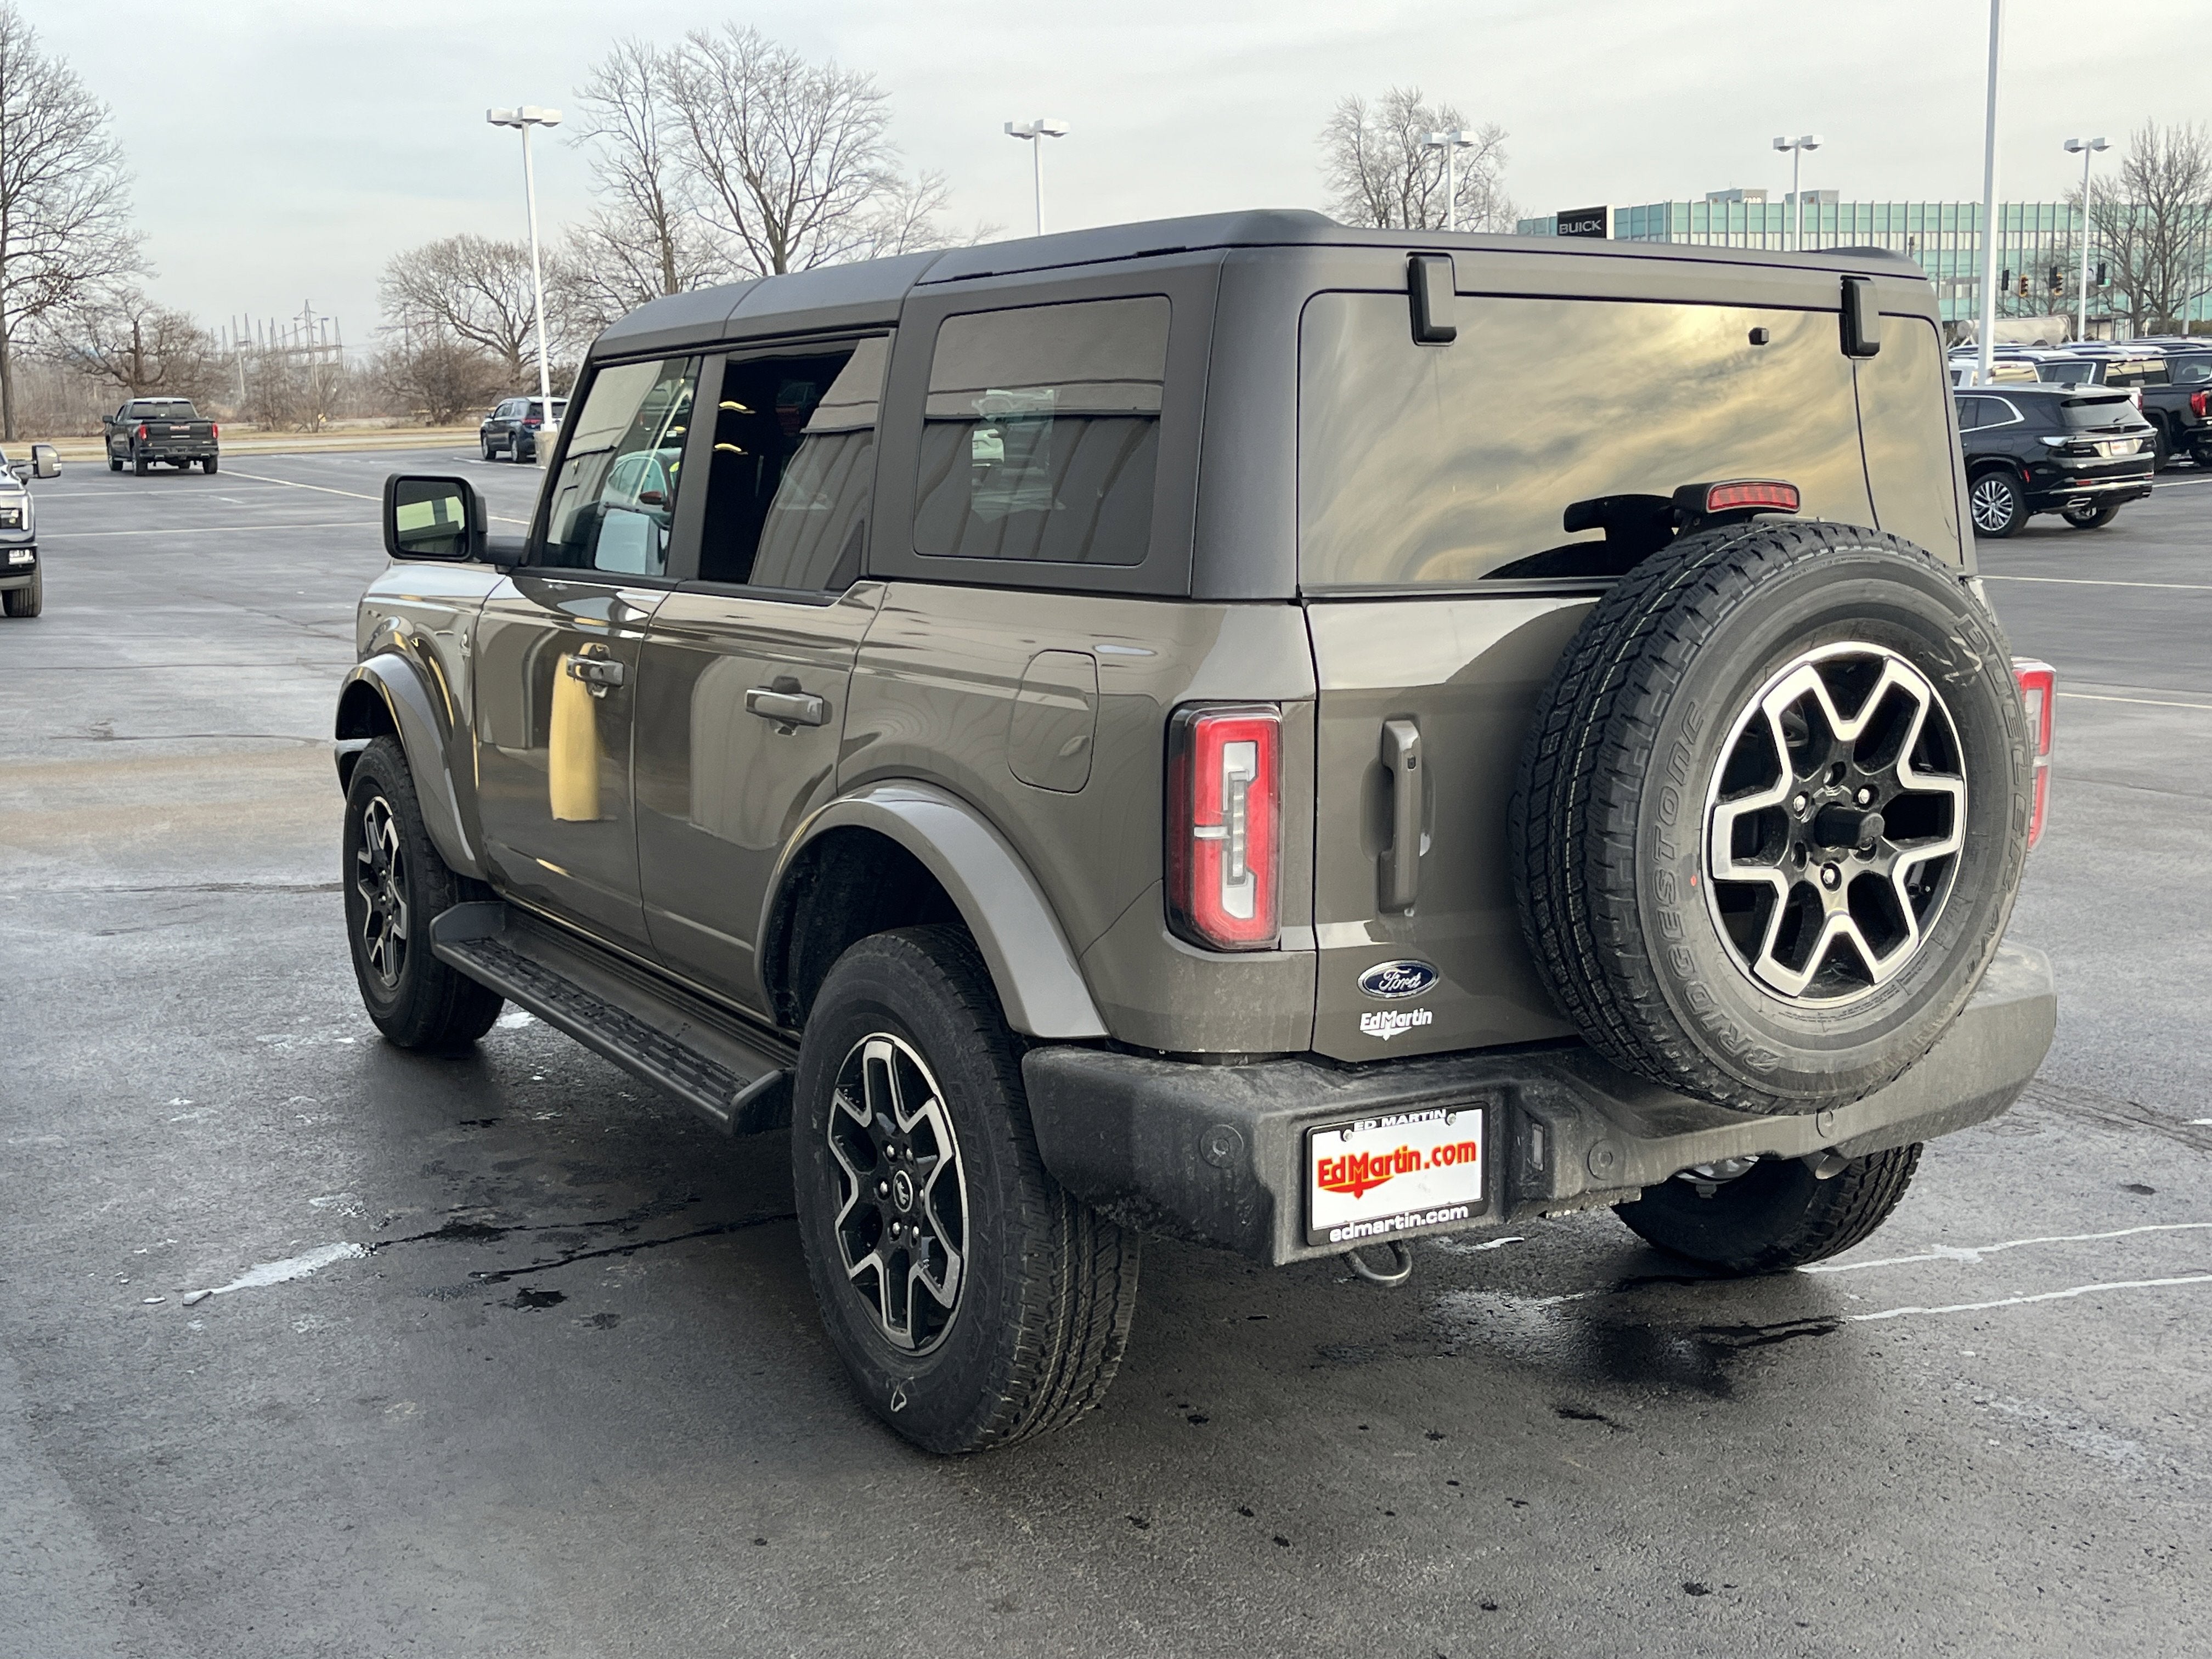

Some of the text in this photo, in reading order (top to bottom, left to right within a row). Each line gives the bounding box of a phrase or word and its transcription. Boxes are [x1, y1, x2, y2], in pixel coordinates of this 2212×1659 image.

[1559, 219, 1601, 235] BUICK
[1652, 700, 1780, 1076] BRIDGESTONE
[1379, 968, 1423, 991] Ford
[1359, 1007, 1433, 1032] EdMartin
[1353, 1109, 1447, 1132] ED MARTIN
[1318, 1141, 1476, 1188] EdMartin.com
[1329, 1205, 1469, 1243] edmartin.com
